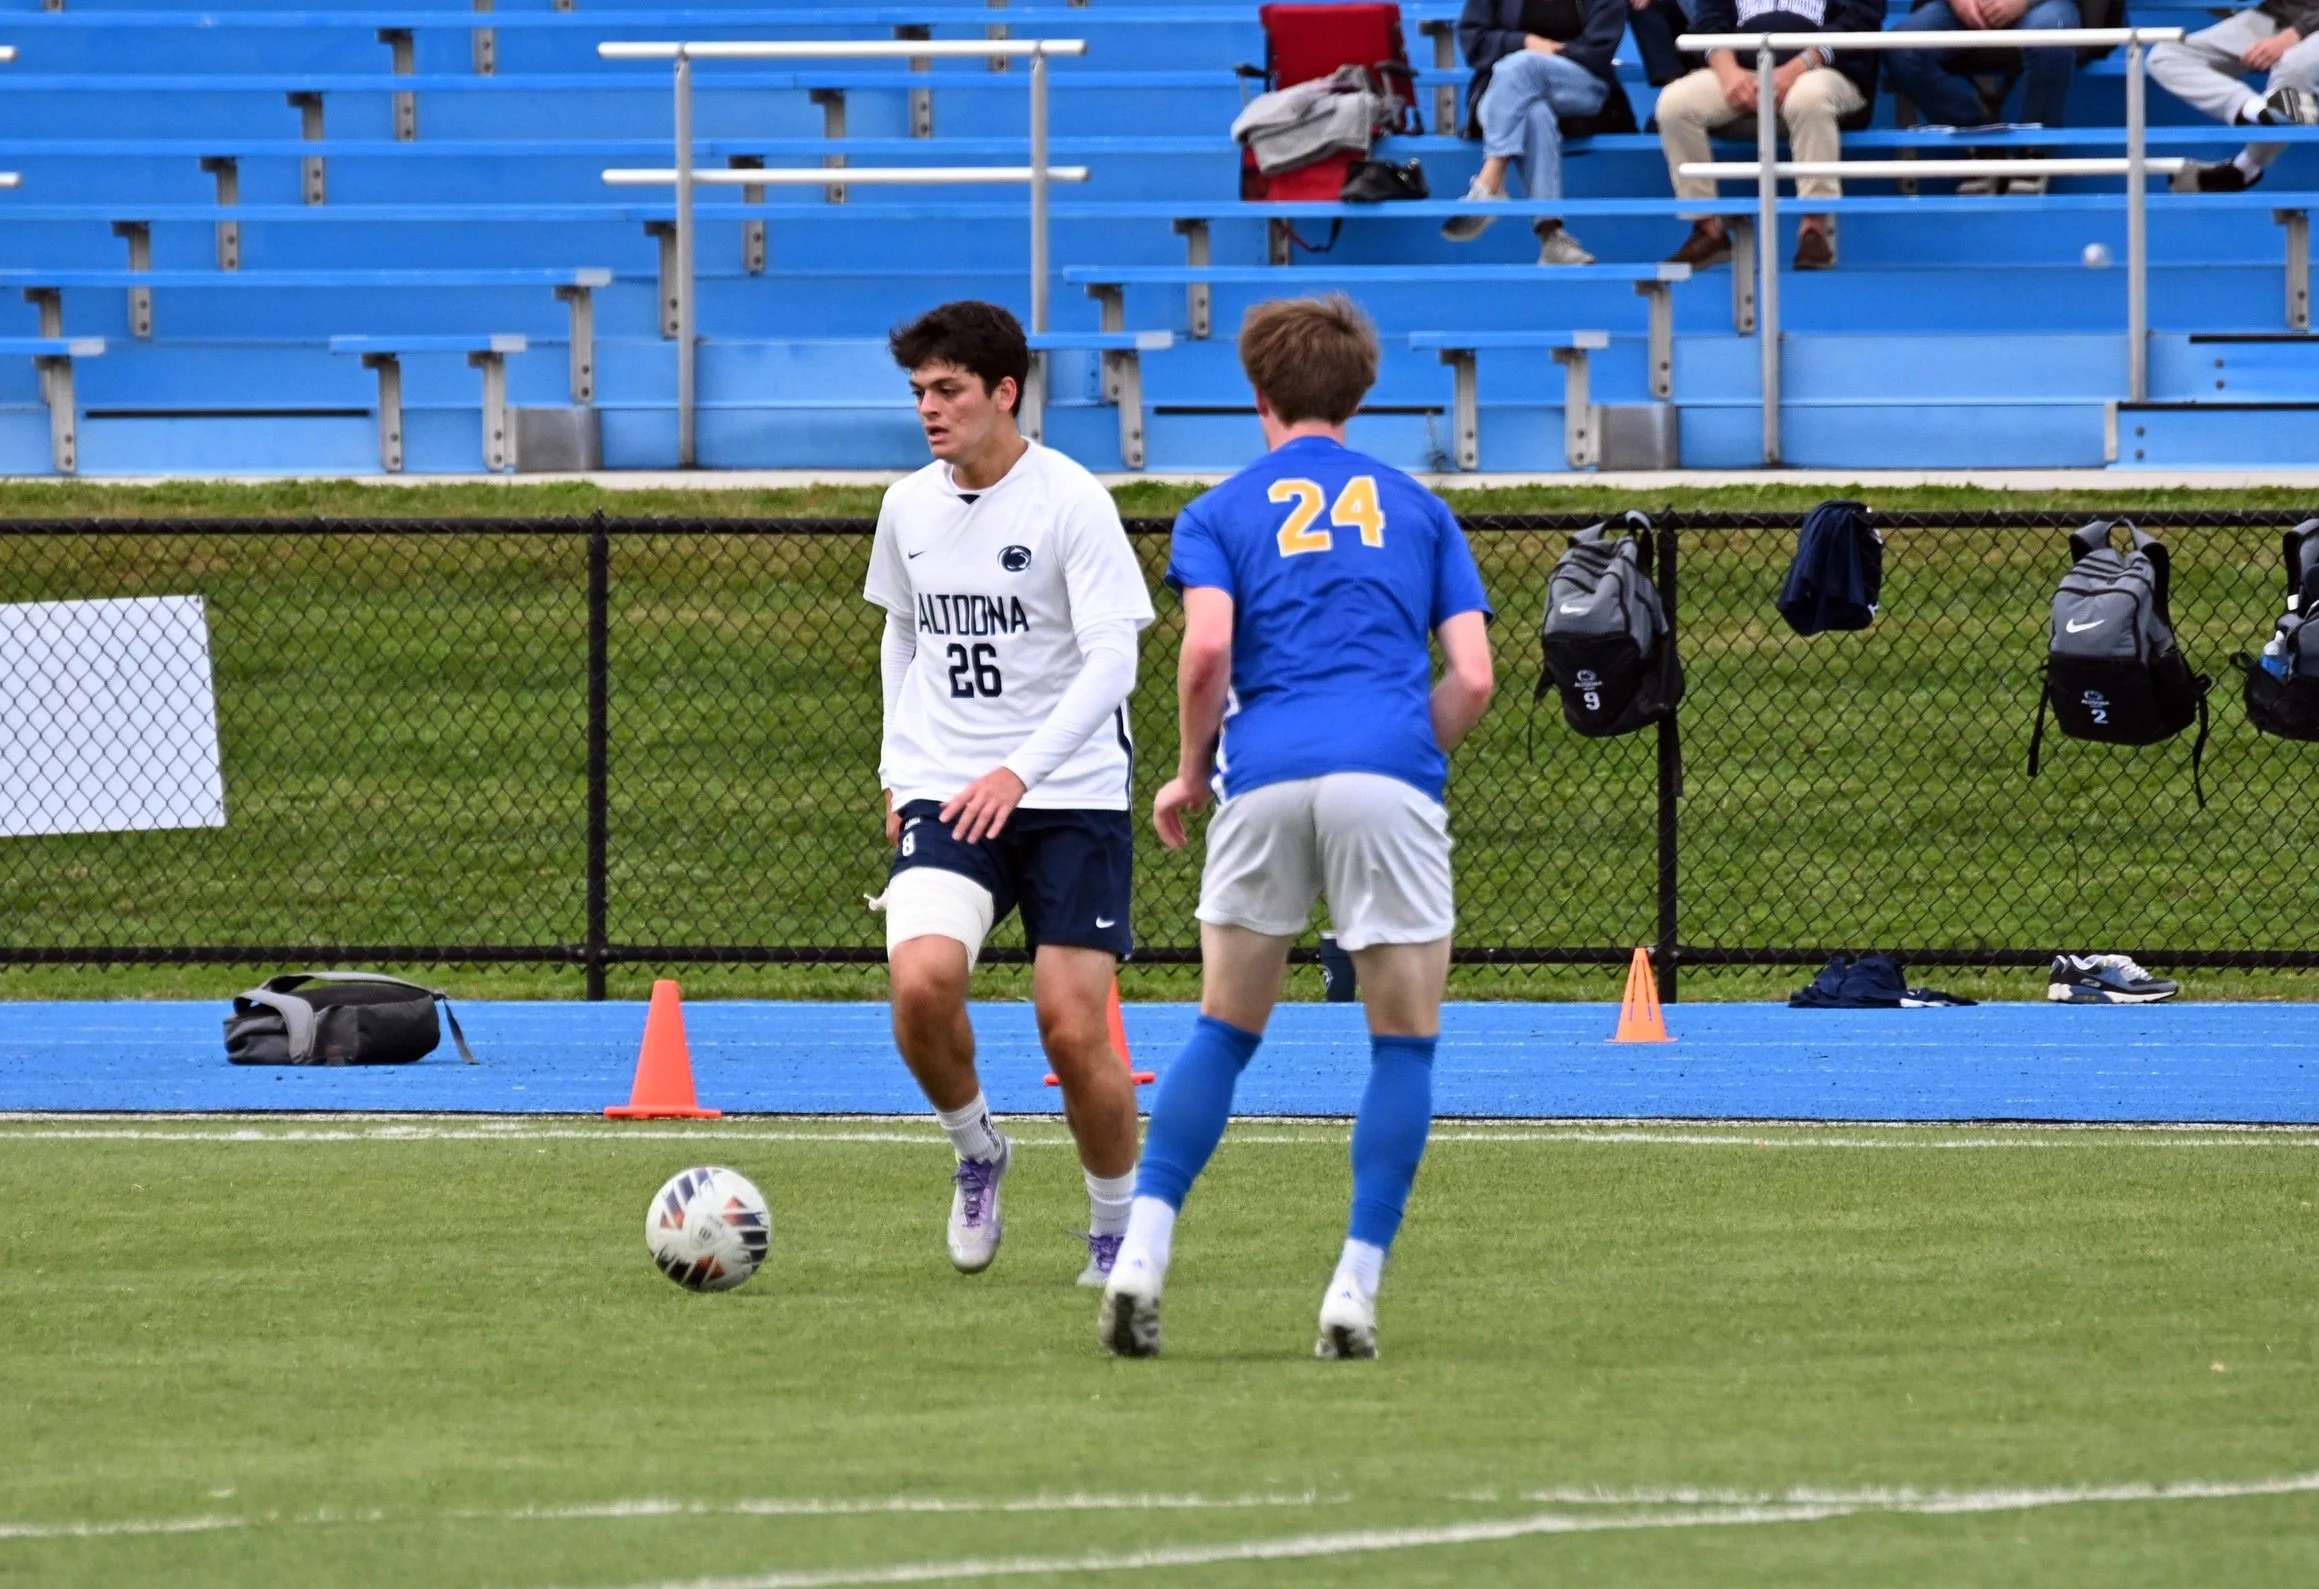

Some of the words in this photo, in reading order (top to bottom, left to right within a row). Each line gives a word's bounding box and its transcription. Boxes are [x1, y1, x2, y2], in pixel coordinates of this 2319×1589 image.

[1267, 475, 1386, 558] 24
[918, 592, 1030, 637] ALTOONA
[946, 642, 1003, 699] 26
[1584, 691, 1600, 711] 9
[2091, 709, 2109, 724] 2
